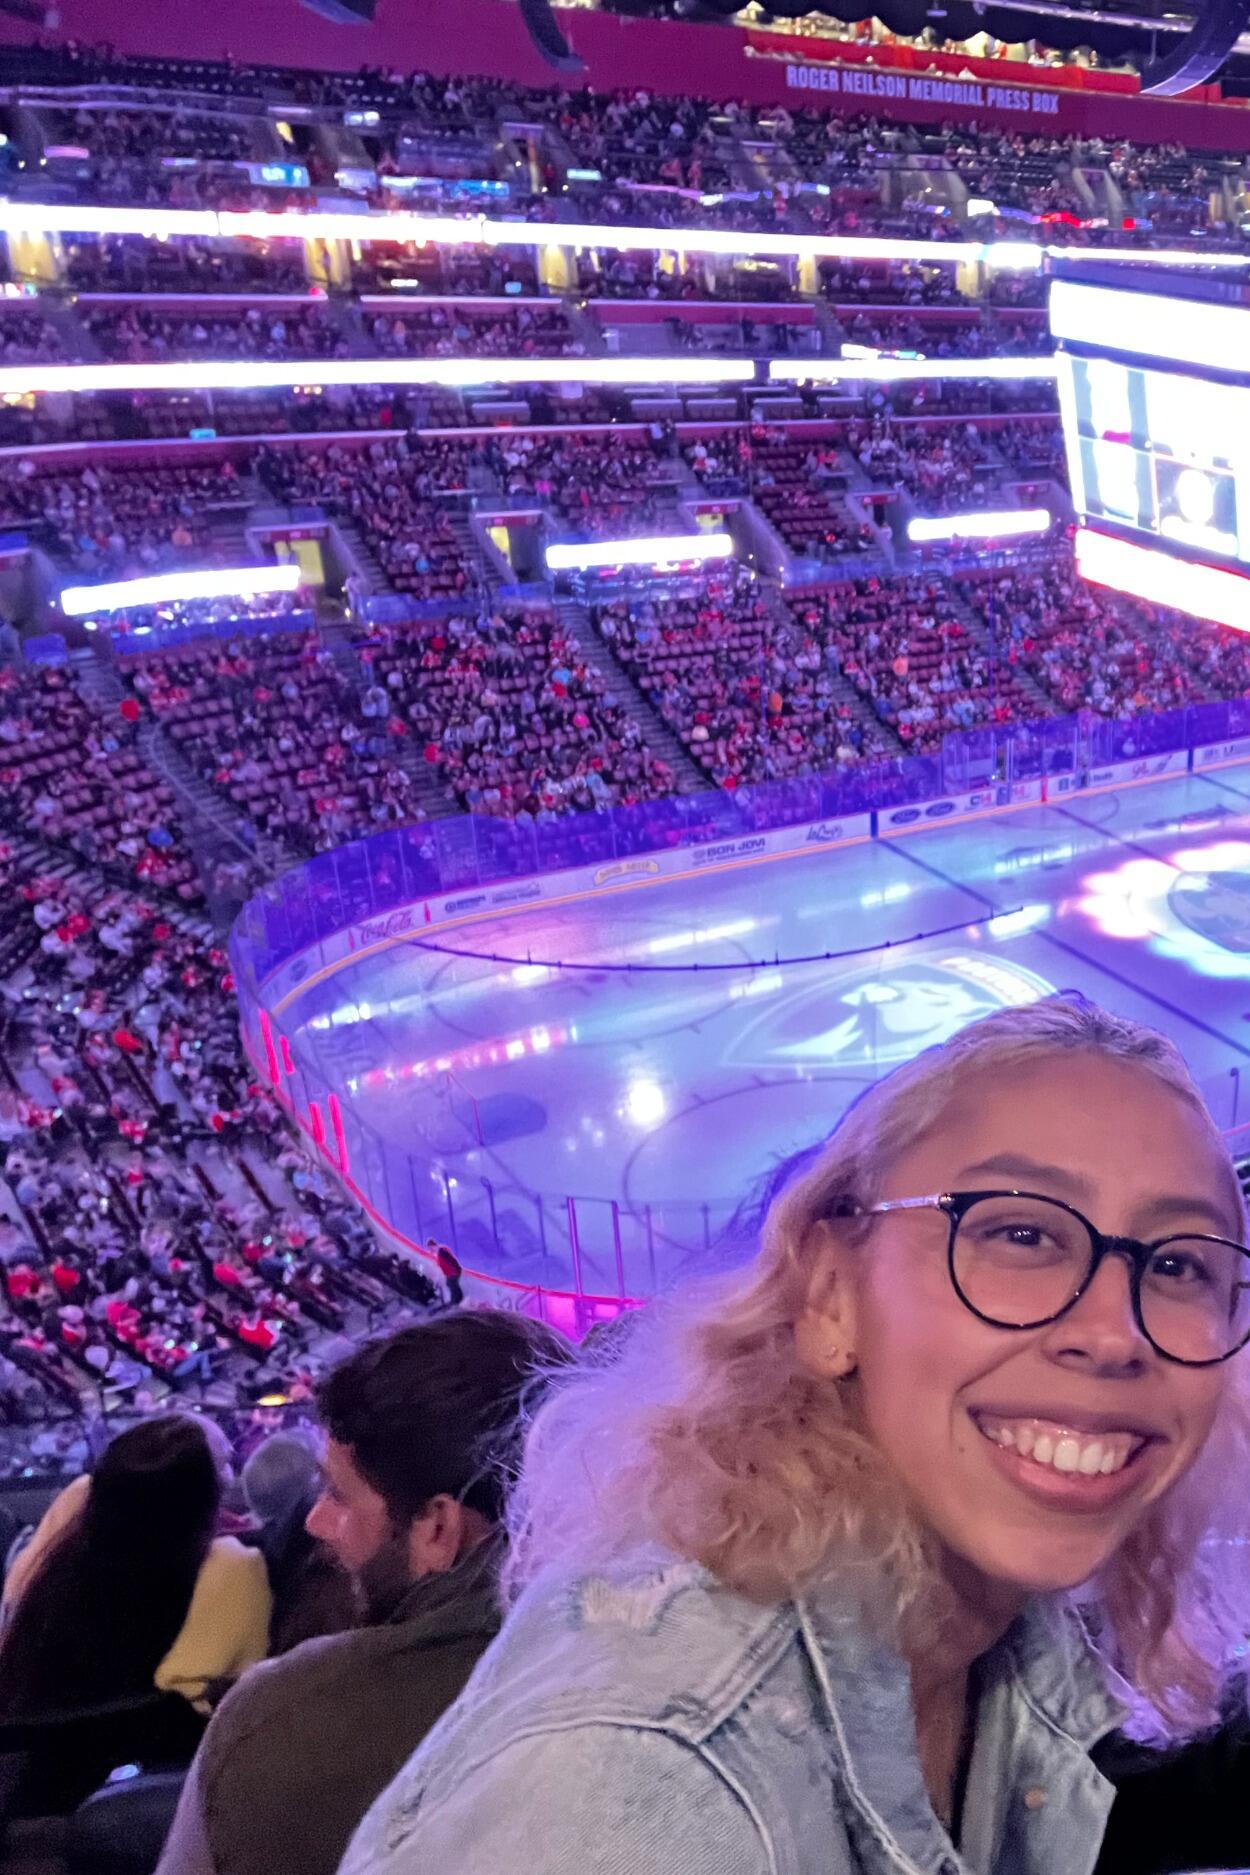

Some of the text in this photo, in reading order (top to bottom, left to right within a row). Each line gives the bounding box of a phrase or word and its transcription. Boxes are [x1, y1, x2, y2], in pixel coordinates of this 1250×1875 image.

[786, 65, 1058, 114] ROGER NEILSON MEMORIAL PRESS BOX
[707, 842, 735, 857] BON
[738, 837, 765, 851] JOVI
